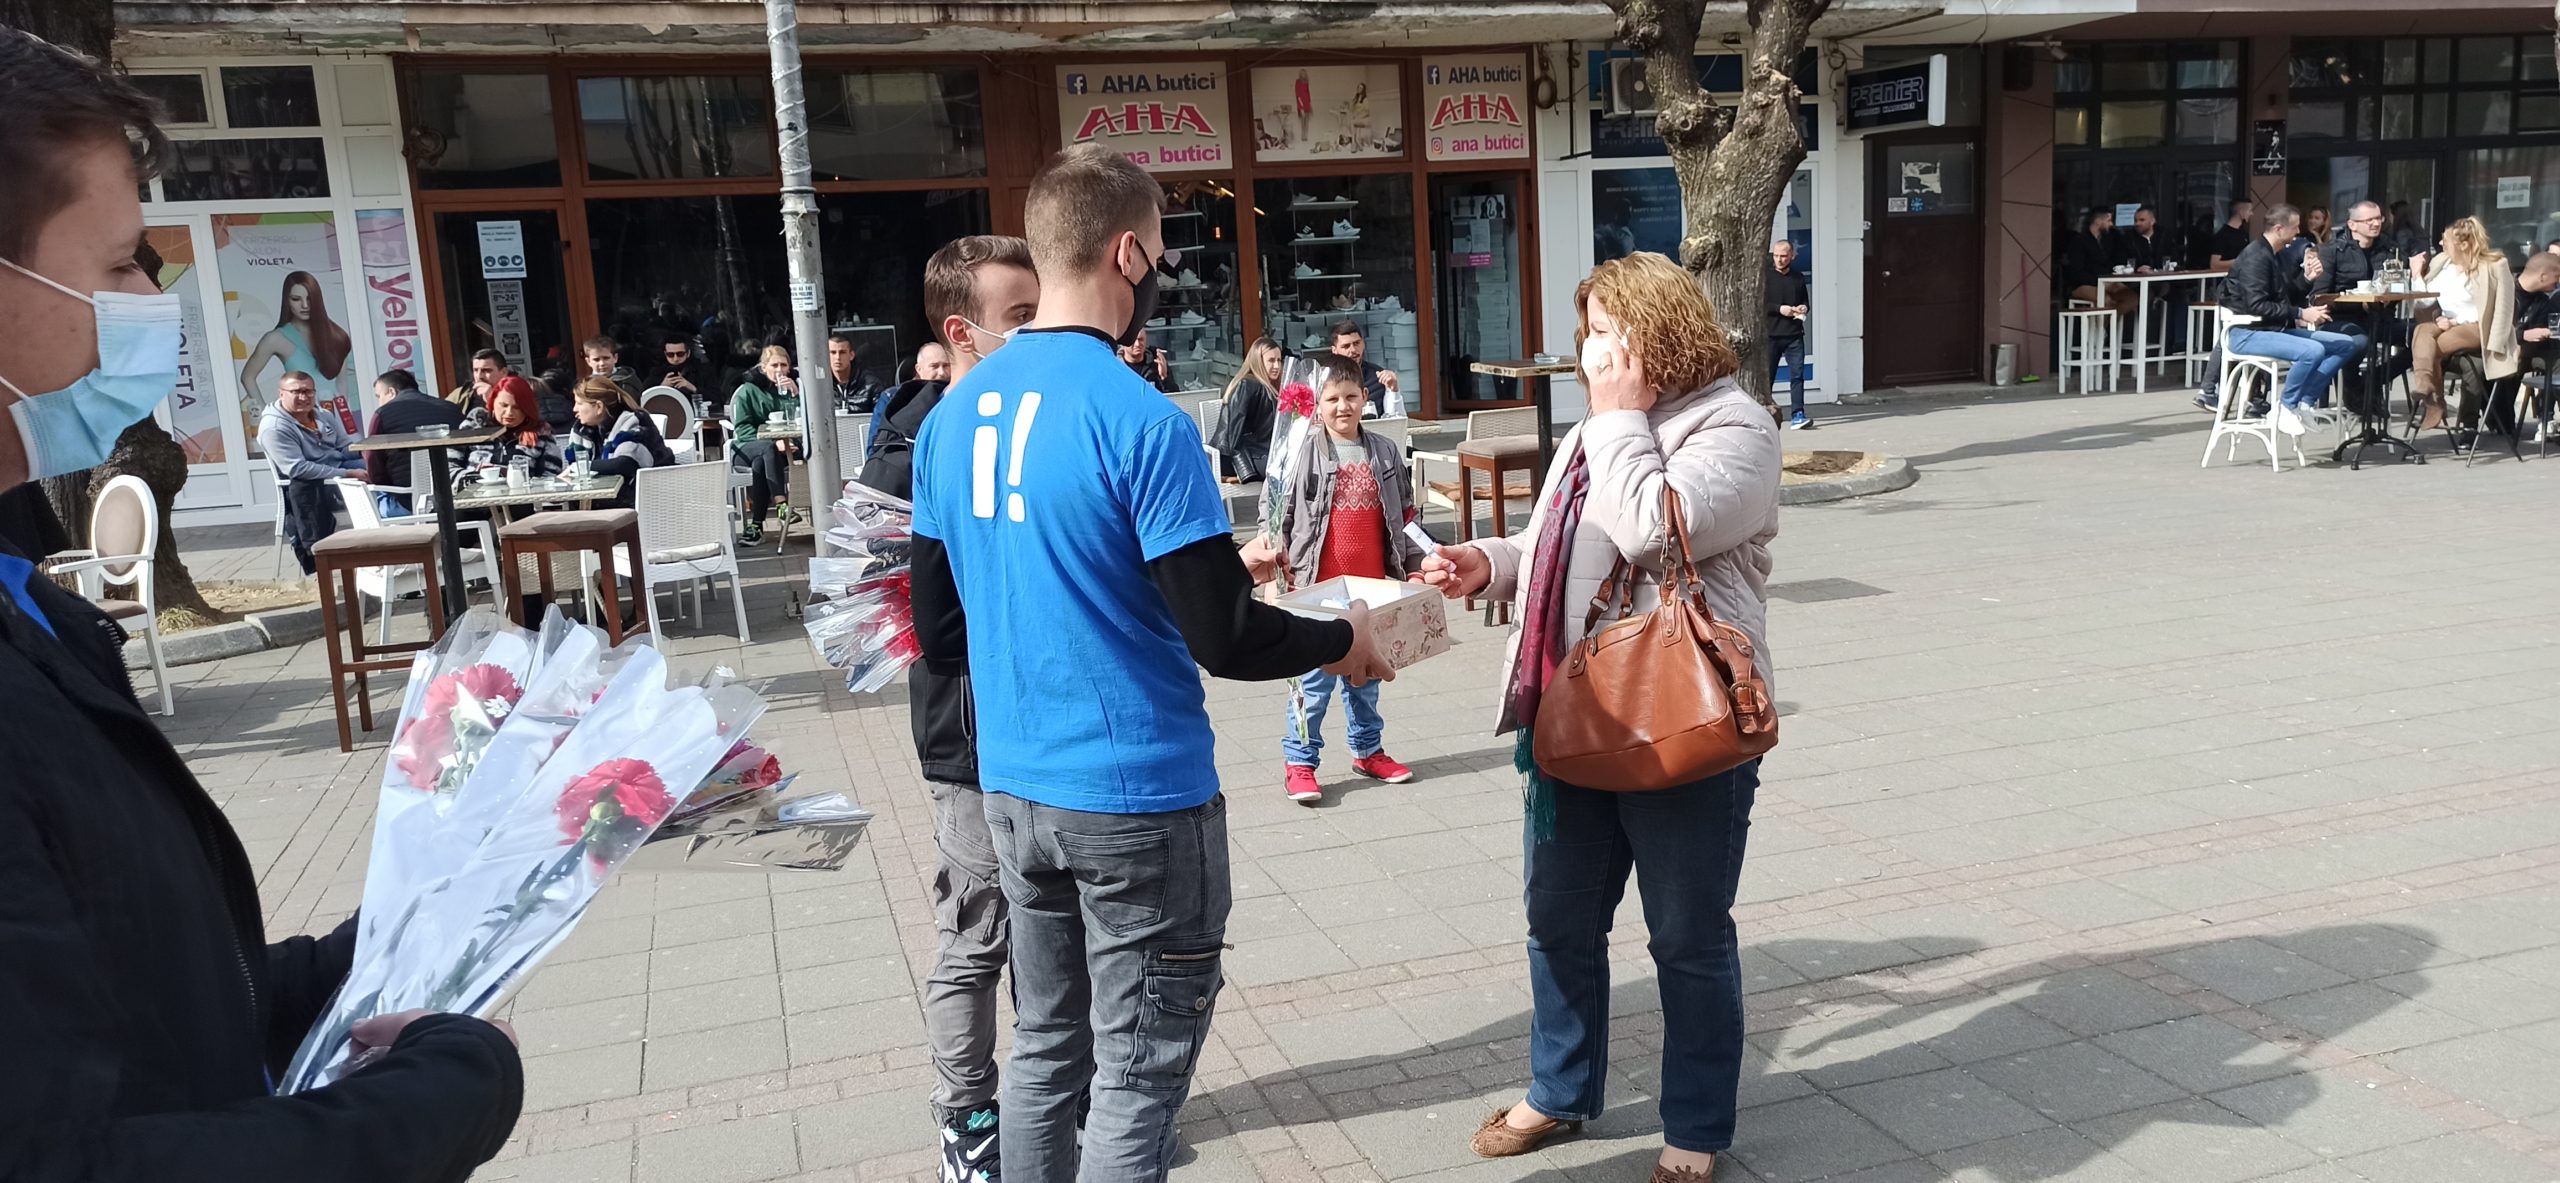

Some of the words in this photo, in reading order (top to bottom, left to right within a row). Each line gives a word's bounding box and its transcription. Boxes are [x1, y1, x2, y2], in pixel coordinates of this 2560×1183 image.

[1101, 74, 1152, 93] AHA
[1156, 72, 1216, 91] butici
[1448, 66, 1480, 84] AHA
[1483, 65, 1521, 82] butici
[1851, 76, 1924, 108] PREMIER
[1073, 101, 1217, 143] AHA
[1430, 92, 1522, 130] AHA
[246, 257, 294, 267] VIOLETA
[368, 271, 419, 376] yello
